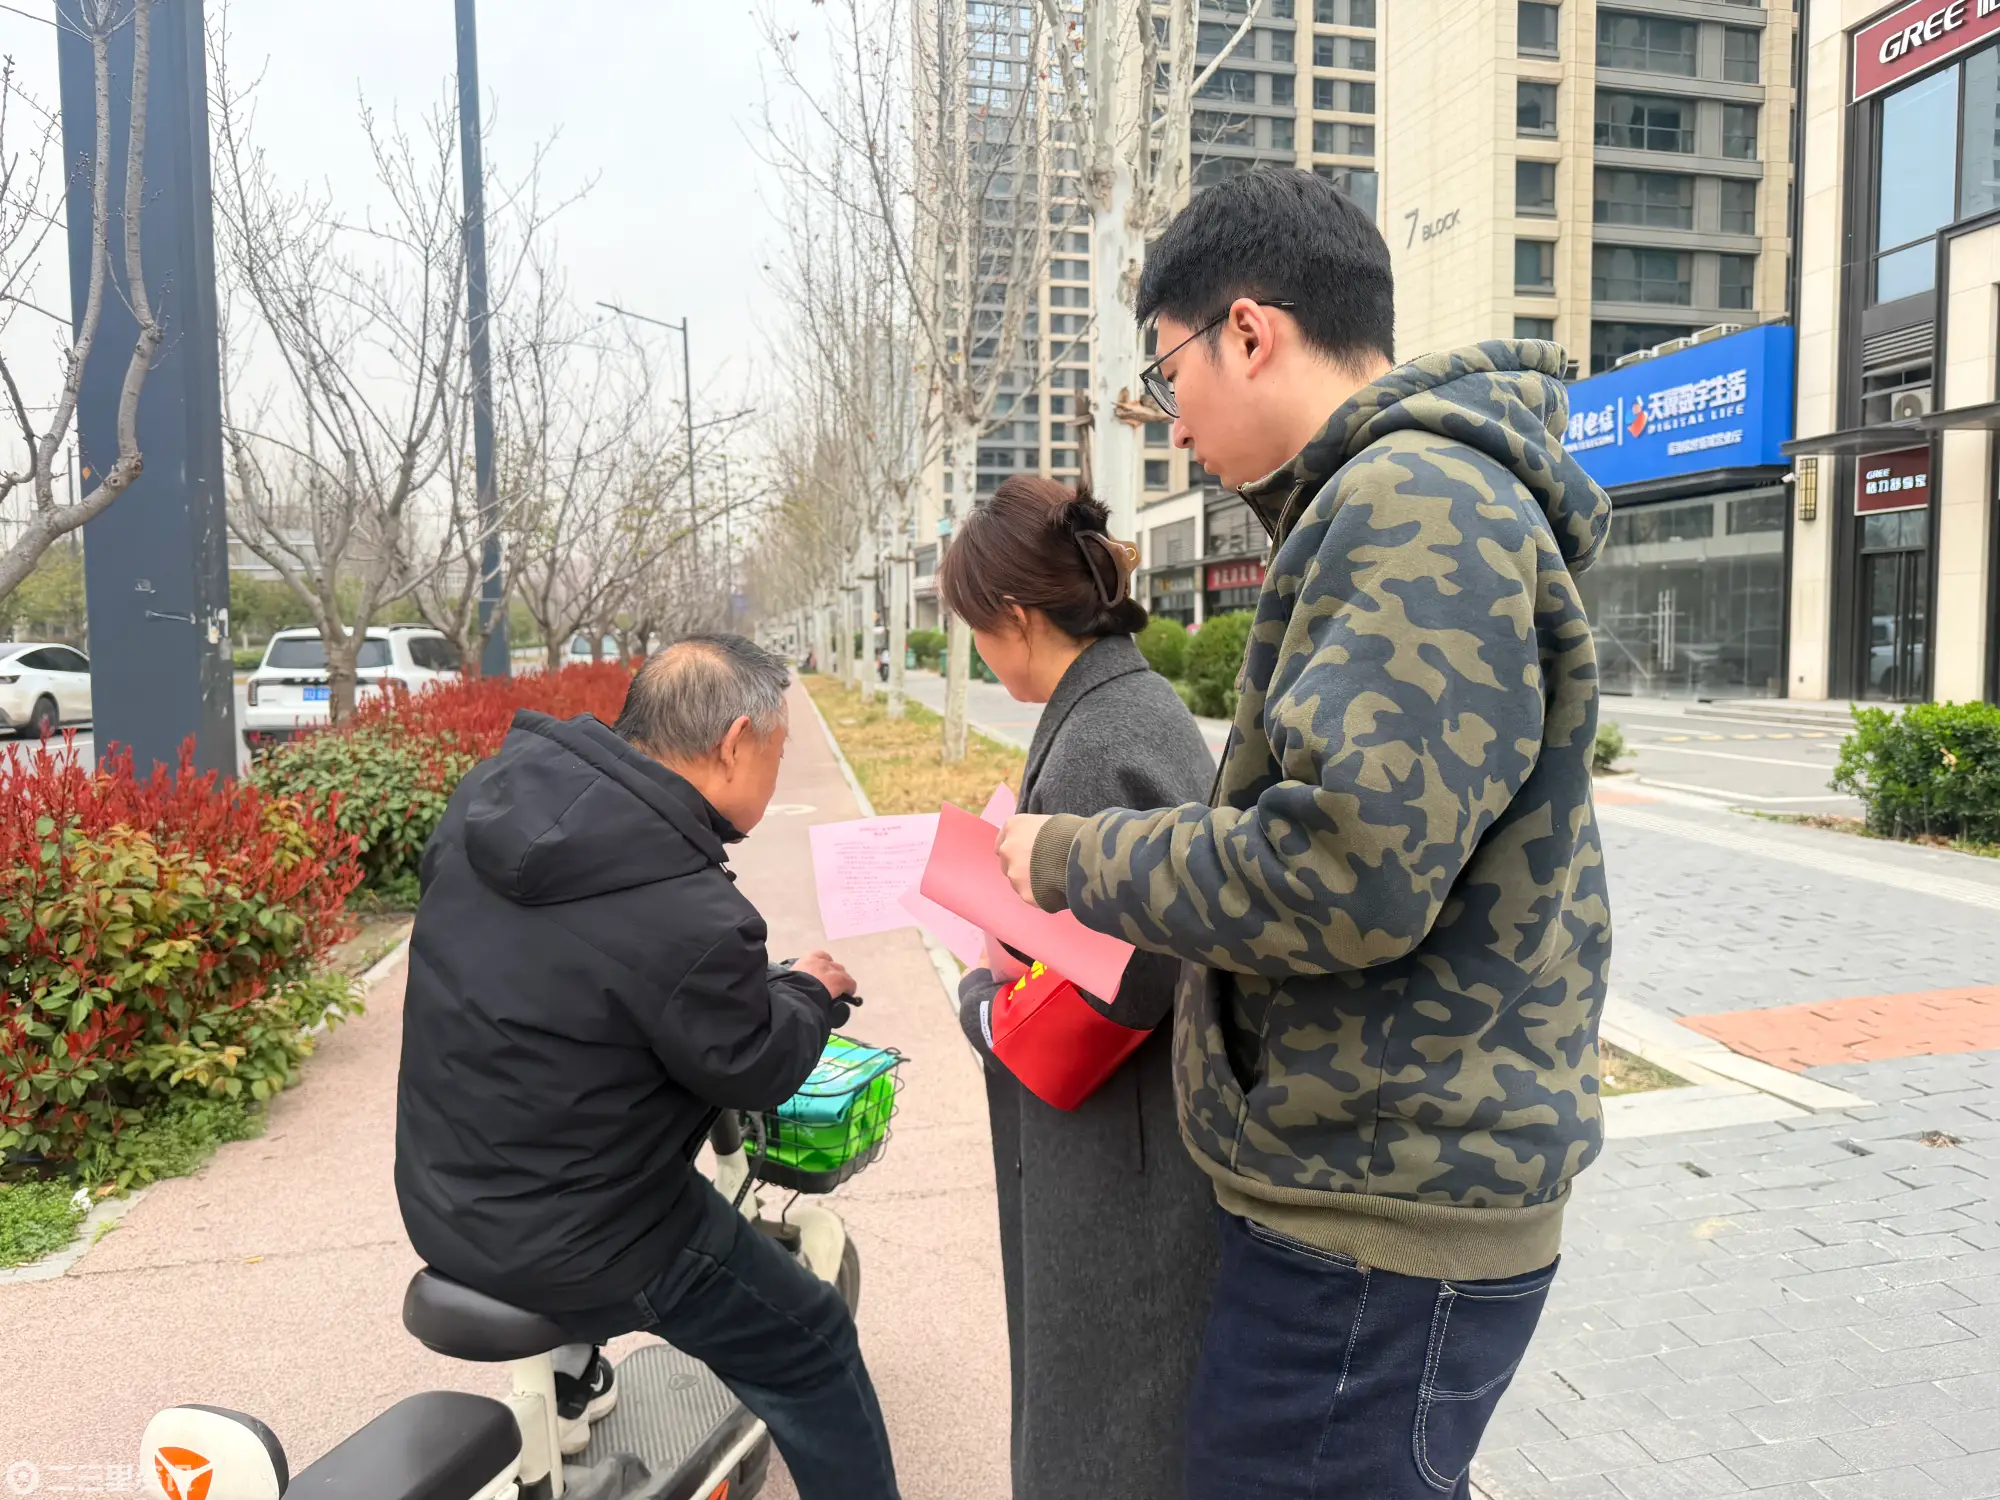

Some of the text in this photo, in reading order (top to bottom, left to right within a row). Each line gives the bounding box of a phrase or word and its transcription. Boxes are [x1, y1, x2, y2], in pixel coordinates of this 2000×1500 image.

[1878, 0, 1966, 64] GREE
[1404, 207, 1461, 250] 7 BLOCK
[1647, 368, 1747, 422] 天翼数字生活
[1647, 403, 1746, 435] DIGITAL LIFE
[1865, 467, 1892, 480] GREE
